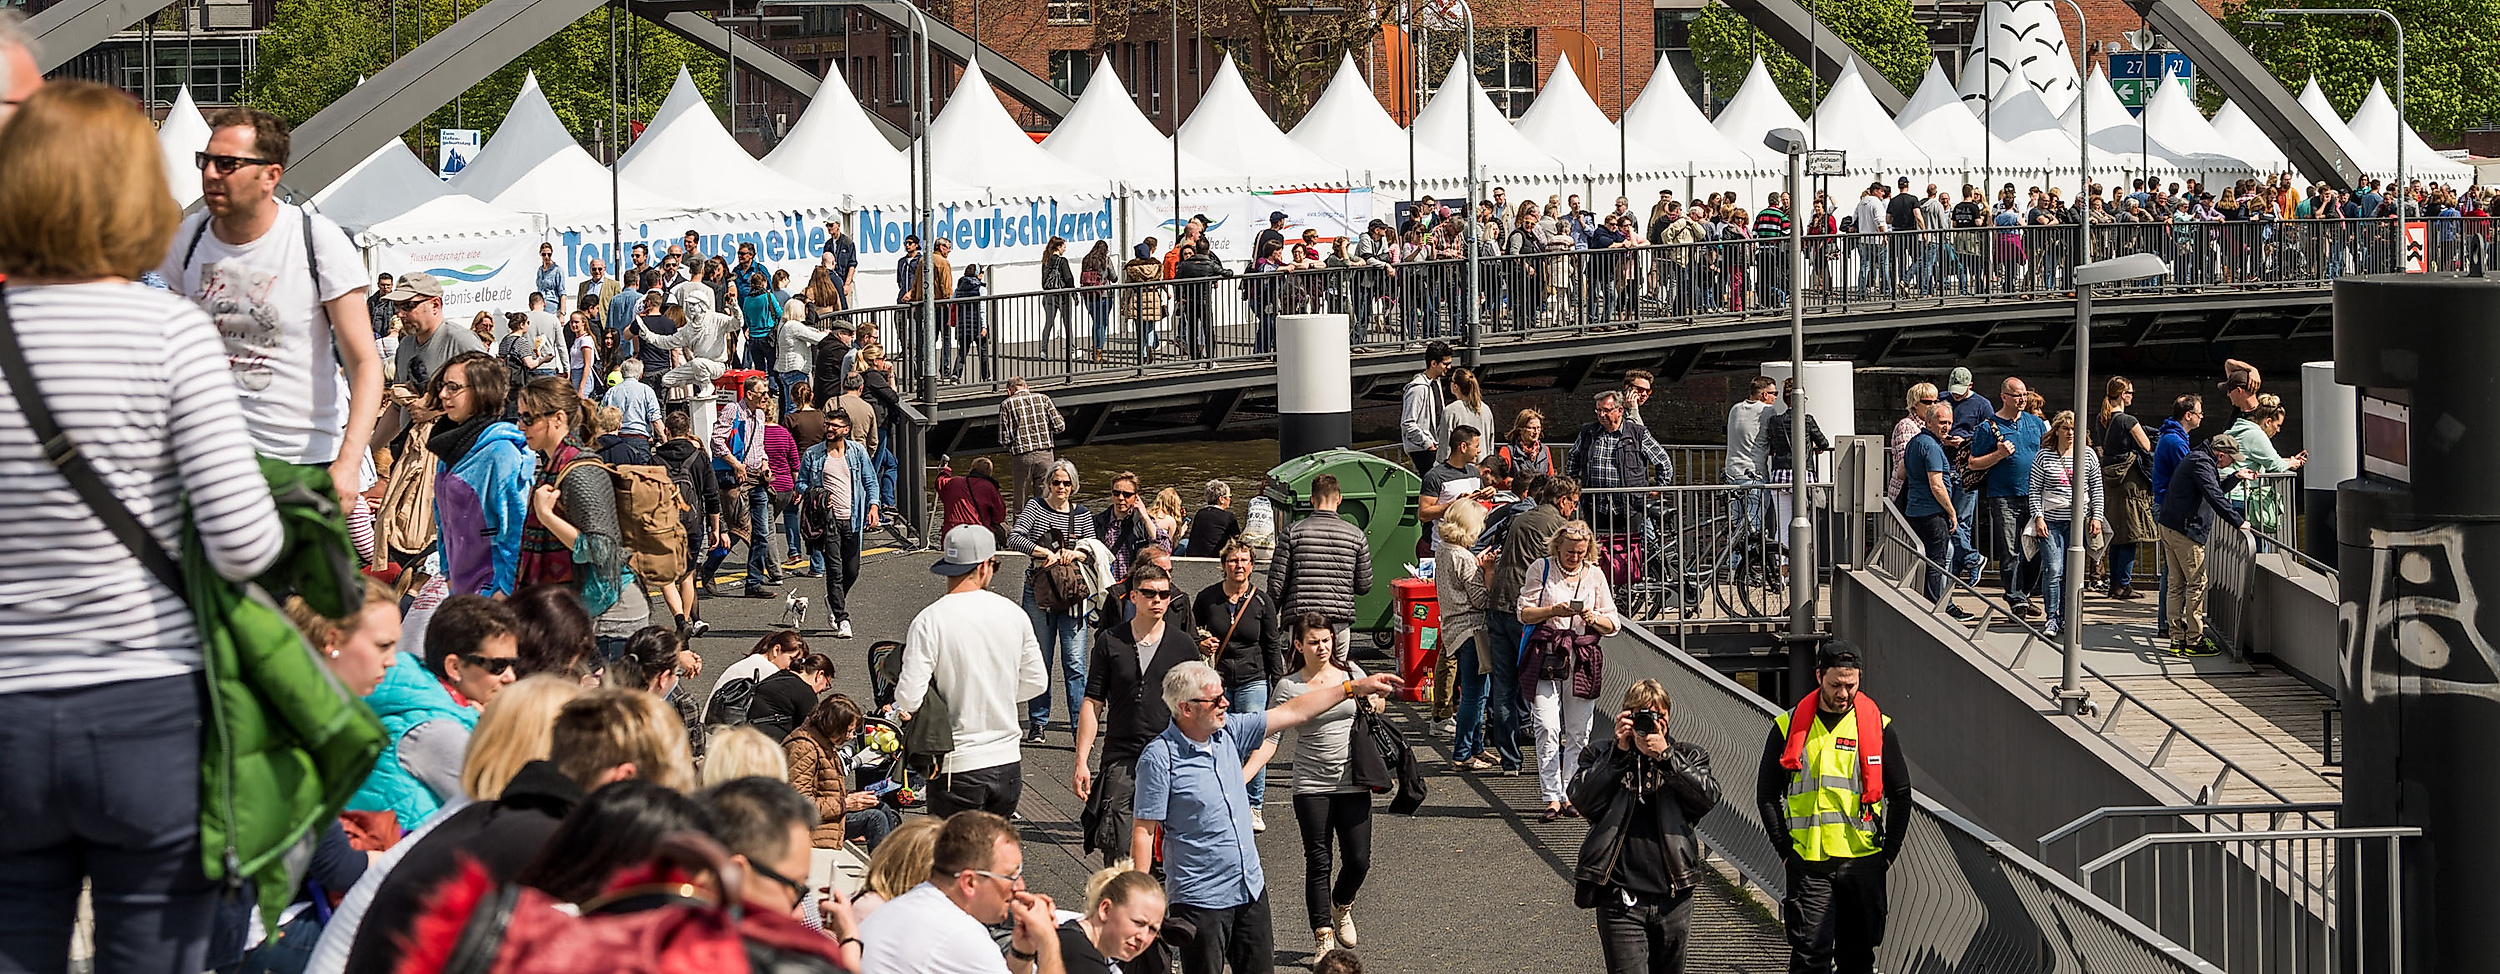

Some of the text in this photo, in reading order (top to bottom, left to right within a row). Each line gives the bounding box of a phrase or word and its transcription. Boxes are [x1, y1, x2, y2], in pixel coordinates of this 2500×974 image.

[2126, 61, 2143, 74] 27
[2173, 60, 2184, 73] 27
[562, 211, 825, 277] Tourisusmeile
